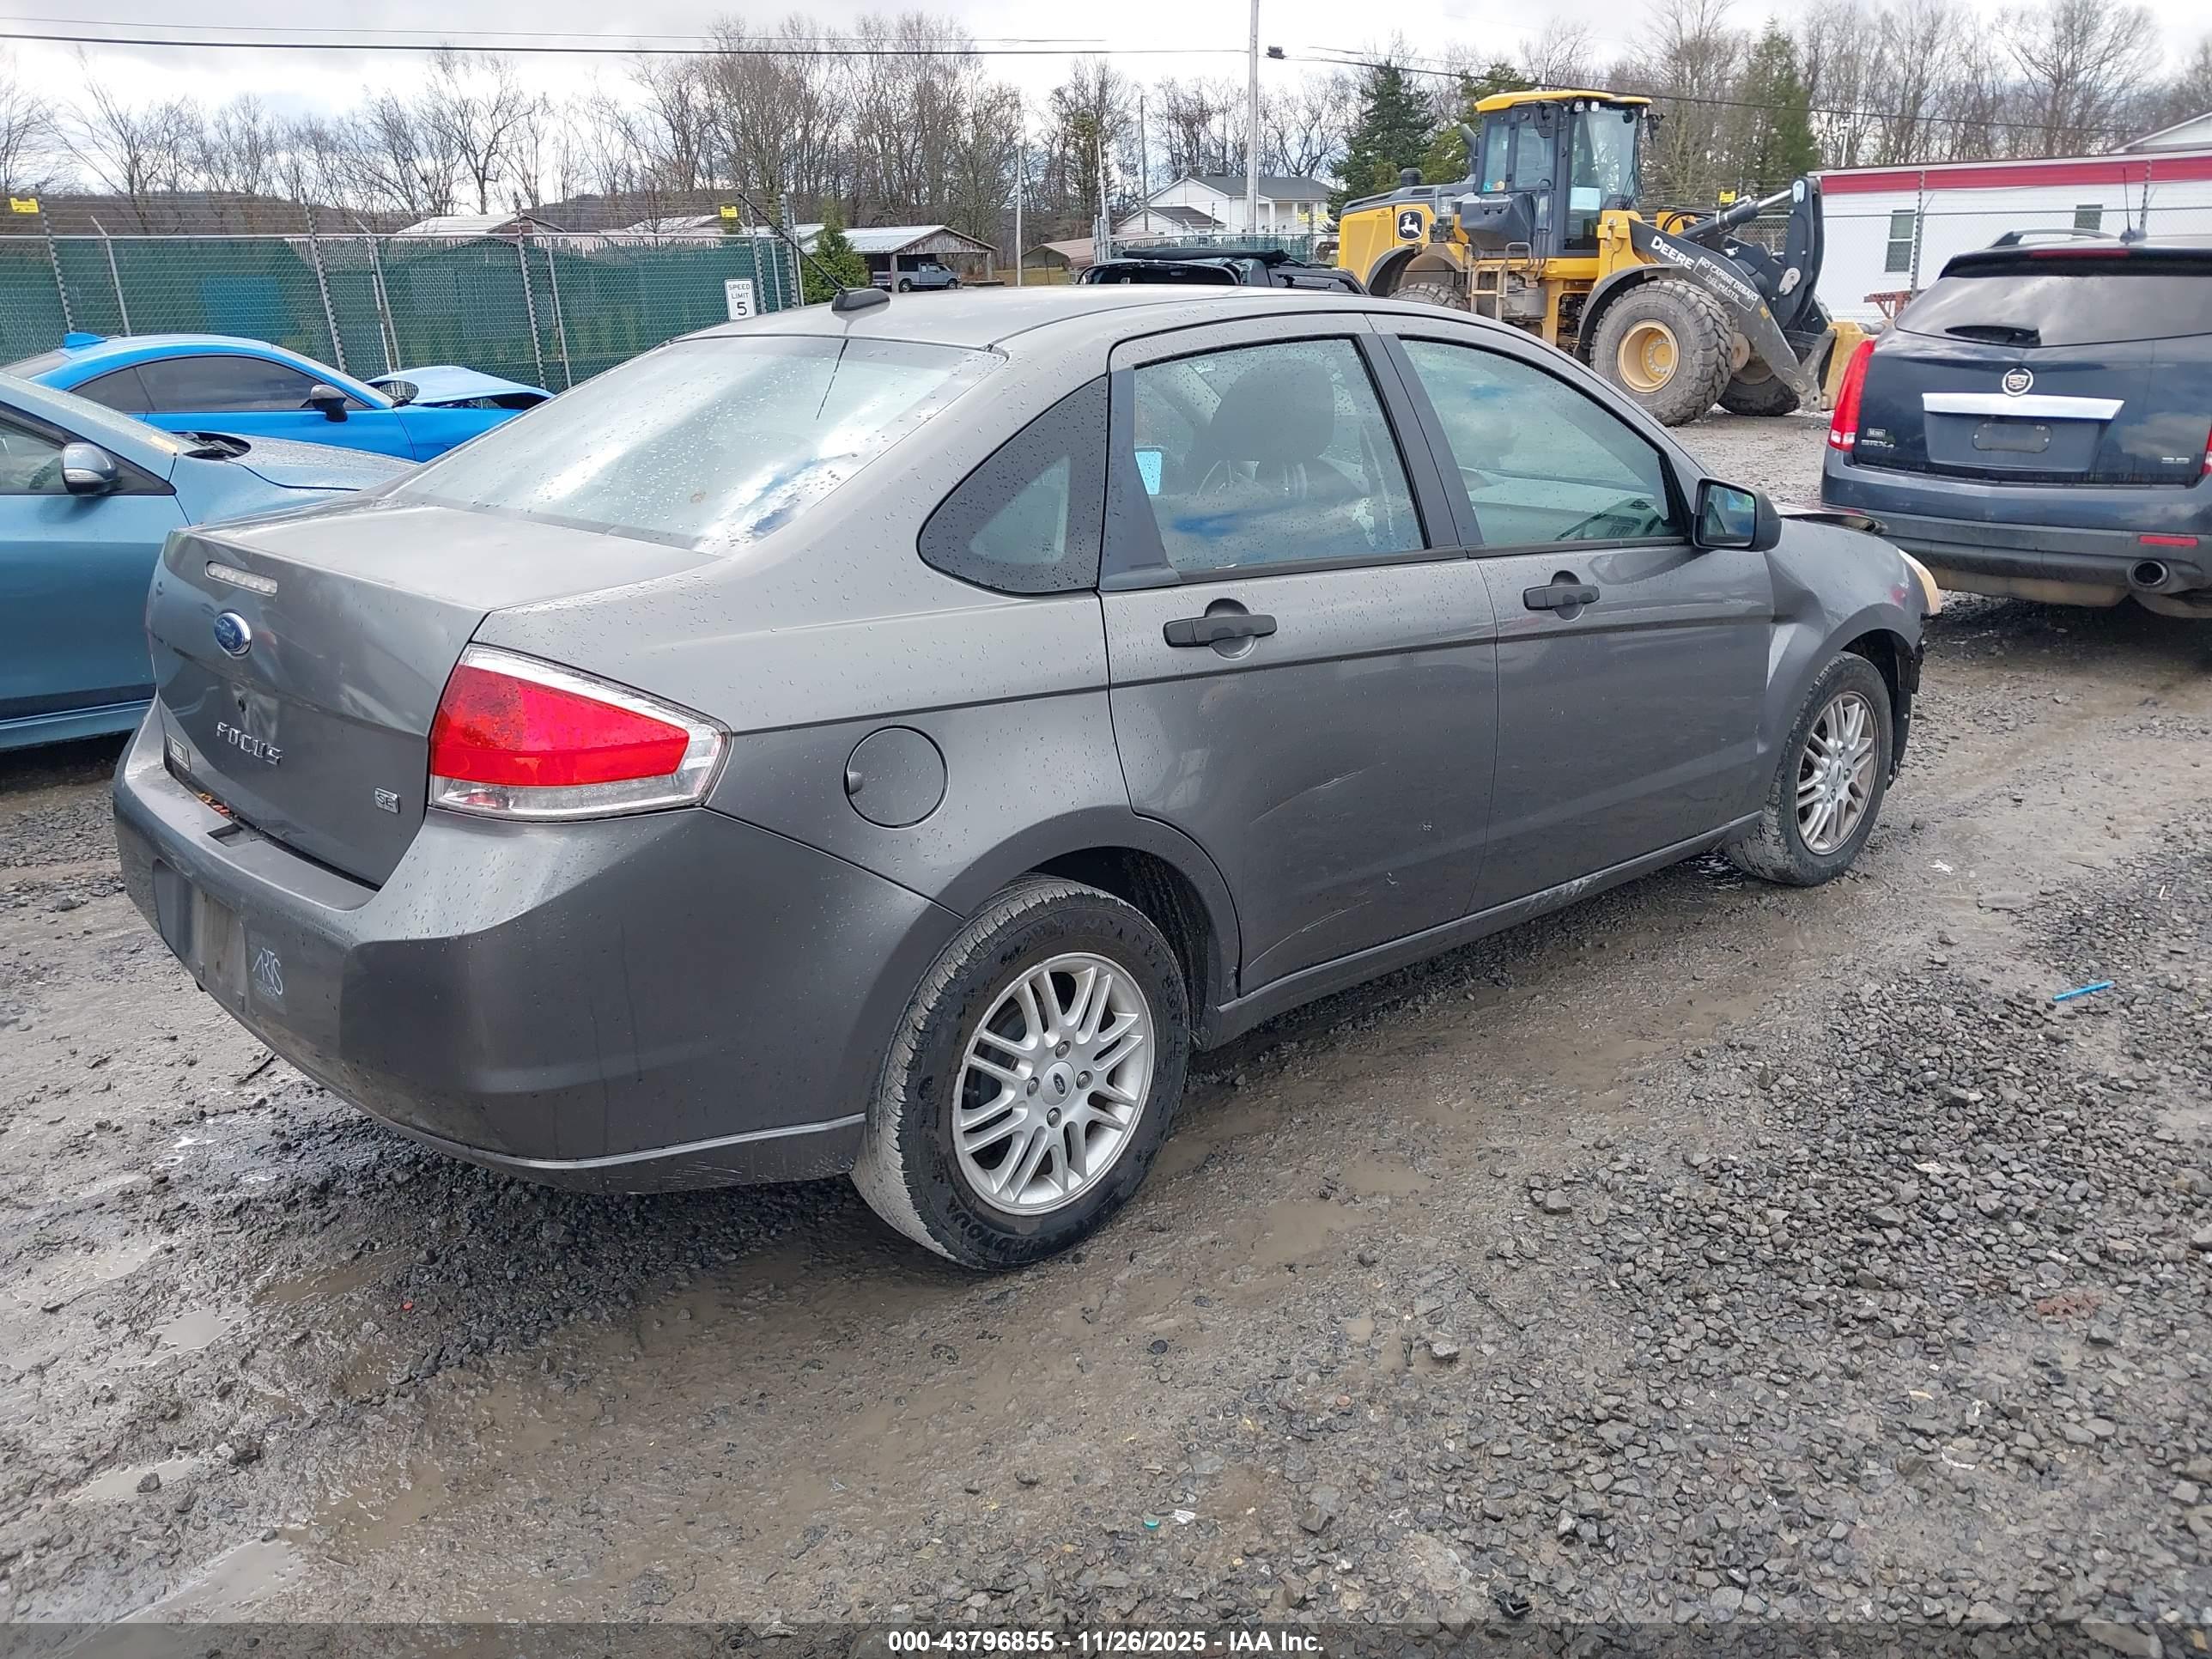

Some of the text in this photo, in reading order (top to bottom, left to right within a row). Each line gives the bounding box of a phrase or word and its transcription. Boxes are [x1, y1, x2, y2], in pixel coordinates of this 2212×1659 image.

[1650, 234, 1695, 270] DEERE
[1733, 281, 1759, 301] DEBAJO
[736, 301, 747, 316] 5
[216, 721, 283, 766] FOCUS
[376, 791, 396, 811] SE
